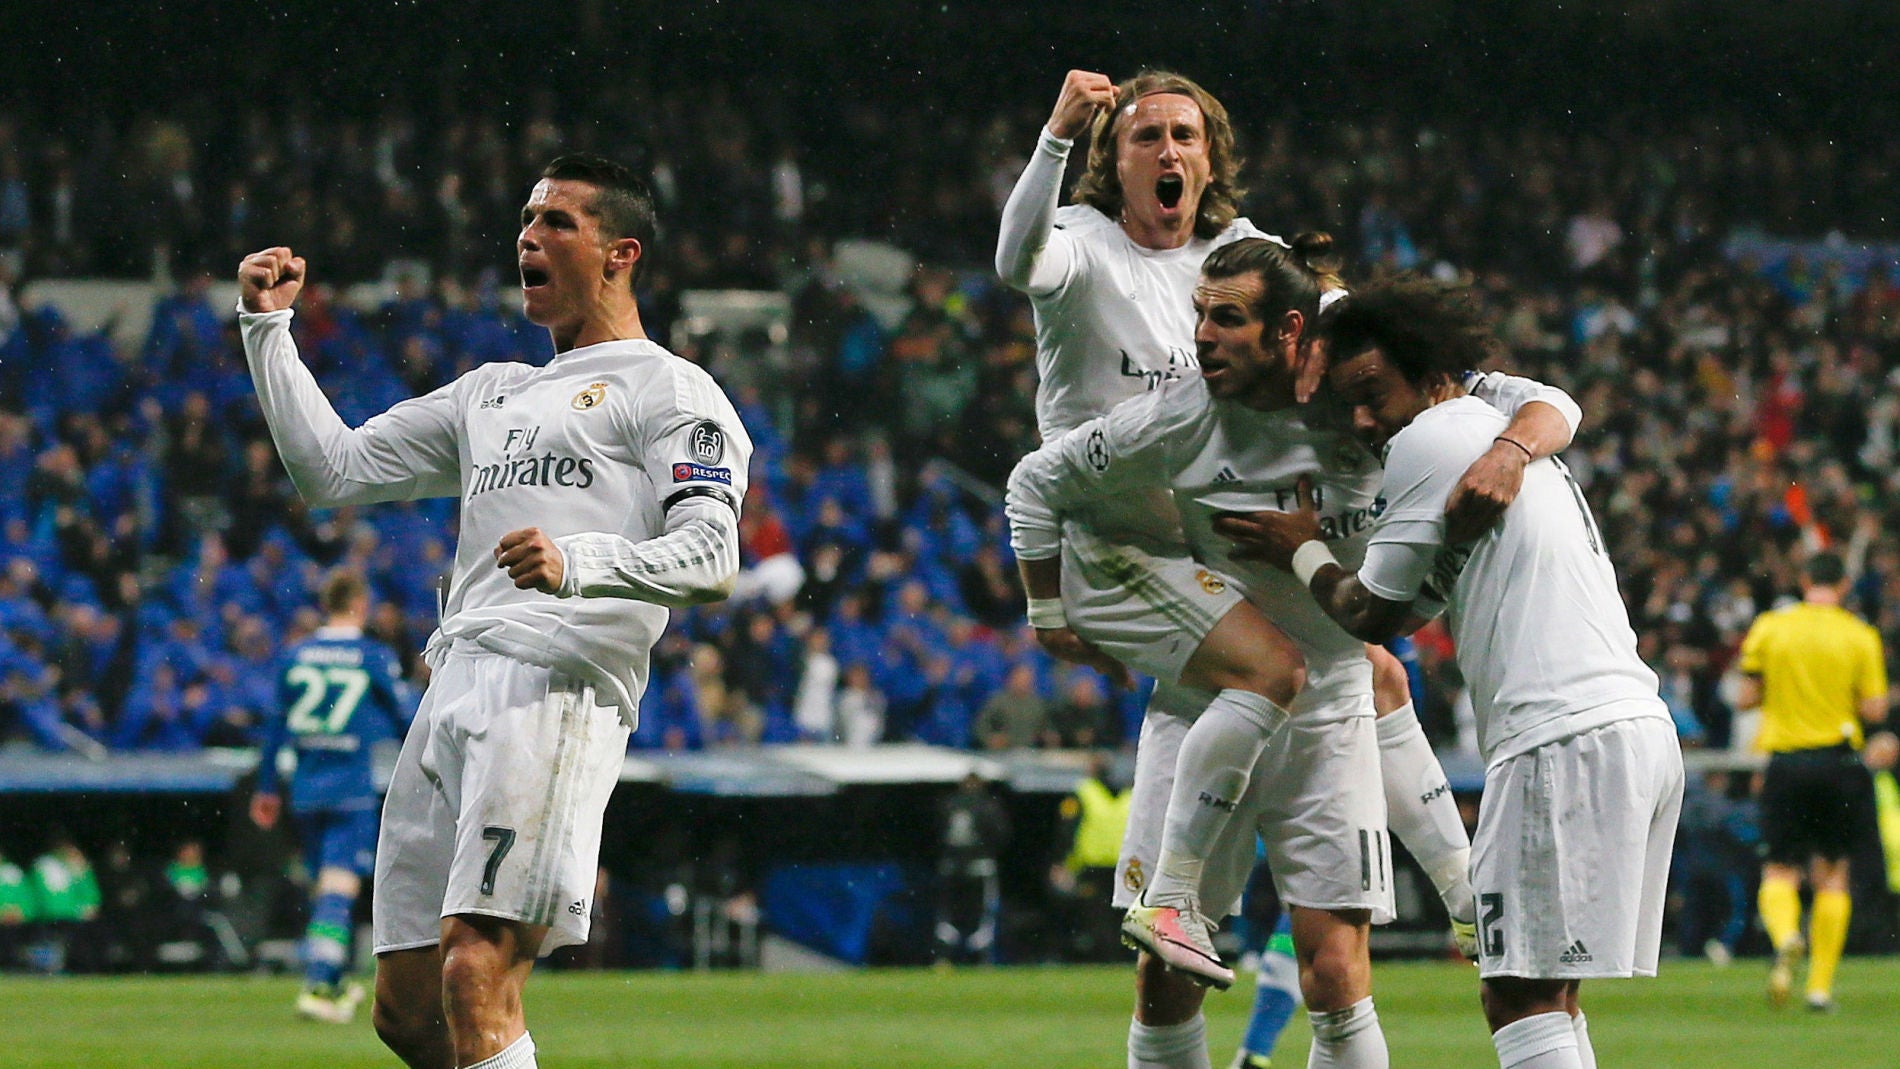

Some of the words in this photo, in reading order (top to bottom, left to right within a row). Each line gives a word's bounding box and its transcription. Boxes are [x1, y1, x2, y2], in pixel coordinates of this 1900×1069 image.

[503, 426, 540, 451] Fly
[699, 443, 714, 458] 10
[692, 467, 731, 480] RESPEC
[286, 665, 370, 733] 27
[480, 825, 516, 896] 7
[1358, 828, 1385, 892] 11
